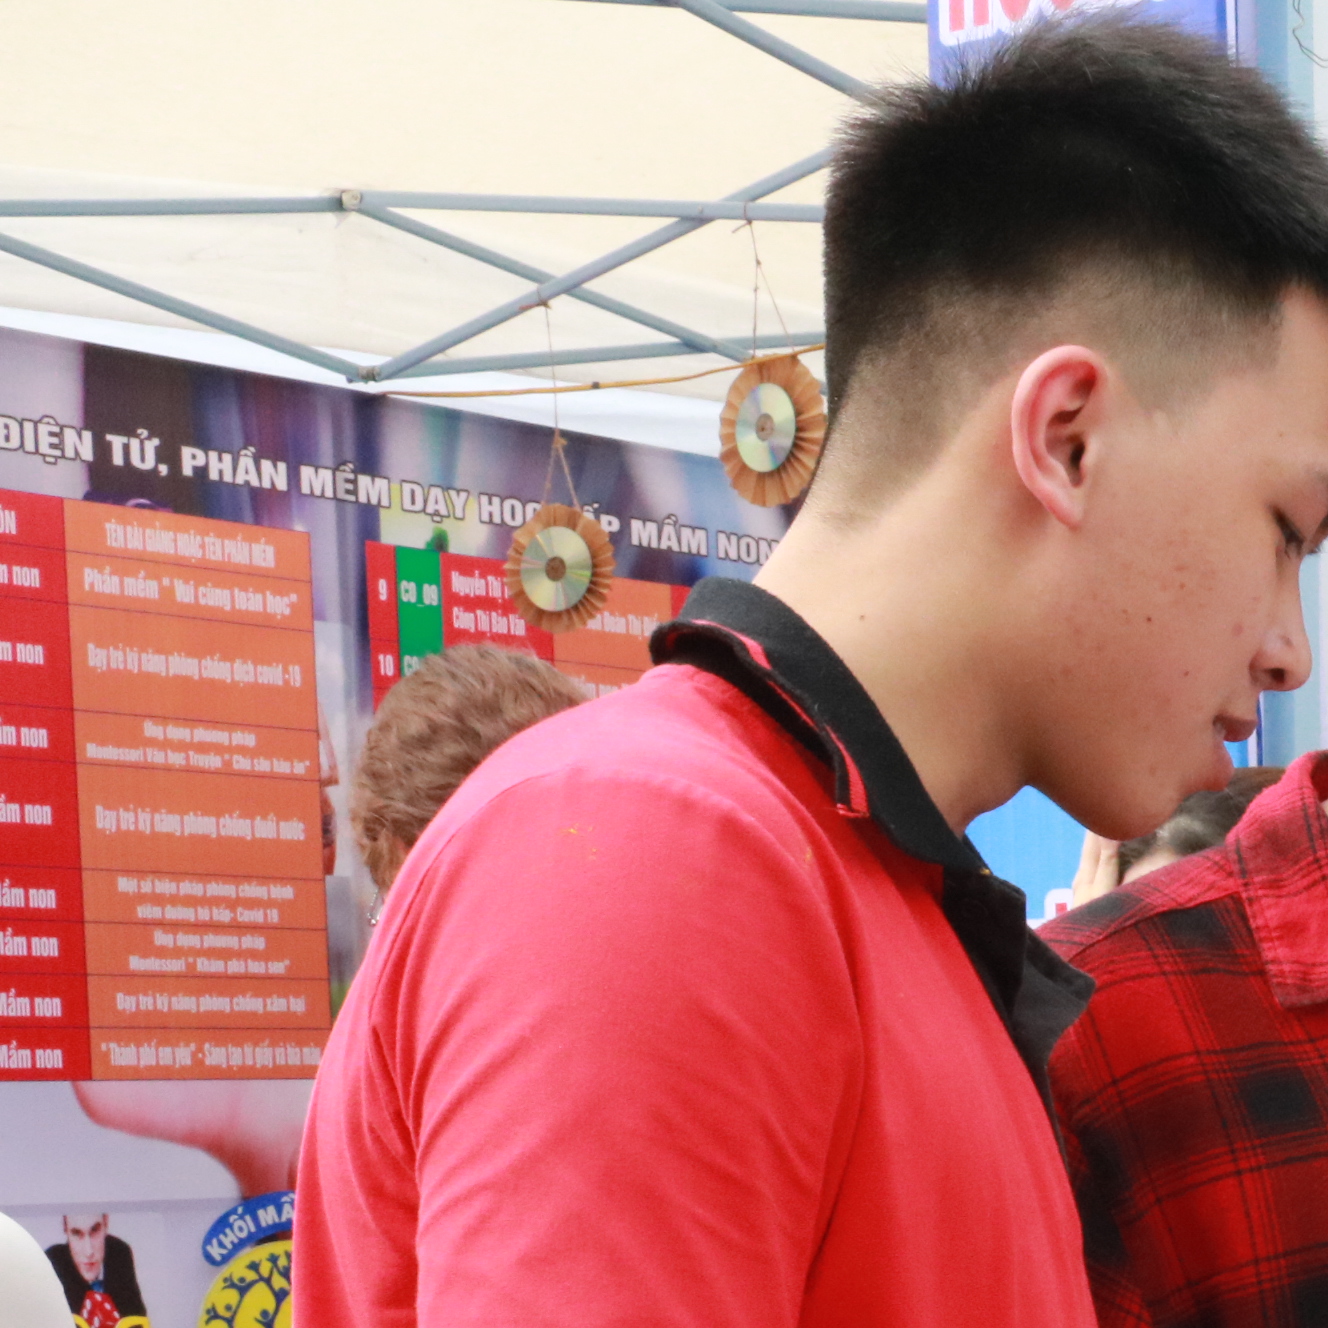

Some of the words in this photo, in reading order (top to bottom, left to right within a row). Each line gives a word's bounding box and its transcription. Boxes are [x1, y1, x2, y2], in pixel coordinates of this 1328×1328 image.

[0, 415, 93, 464] ĐIỆN
[105, 428, 168, 477] TỬ,
[181, 446, 288, 492] PHẦN
[300, 462, 391, 508] MỀM
[401, 482, 469, 523] DẠY
[630, 514, 708, 556] MẦM
[717, 531, 780, 566] NON
[105, 519, 124, 547] TÊN
[127, 524, 143, 549] BÀI
[145, 521, 175, 554] GIẢNG
[204, 532, 222, 561] TÊN
[12, 565, 40, 588] non
[452, 570, 486, 597] Nguyễn
[487, 575, 503, 603] Thị
[84, 566, 120, 595] Phần
[124, 570, 159, 599] mềm
[173, 578, 194, 604] Vui
[198, 586, 231, 611] cùng
[235, 588, 263, 613] toán
[378, 578, 387, 601] 9
[476, 609, 490, 636] Thị
[16, 642, 44, 665] non
[378, 653, 395, 676] 10
[20, 727, 48, 749] non
[24, 803, 52, 825] non
[0, 878, 24, 907] ầm
[28, 888, 56, 909] non
[31, 936, 59, 957] non
[34, 997, 62, 1018] non
[35, 1048, 63, 1069] non
[206, 1206, 257, 1261] KHỐI
[257, 1192, 296, 1228] MẦ
